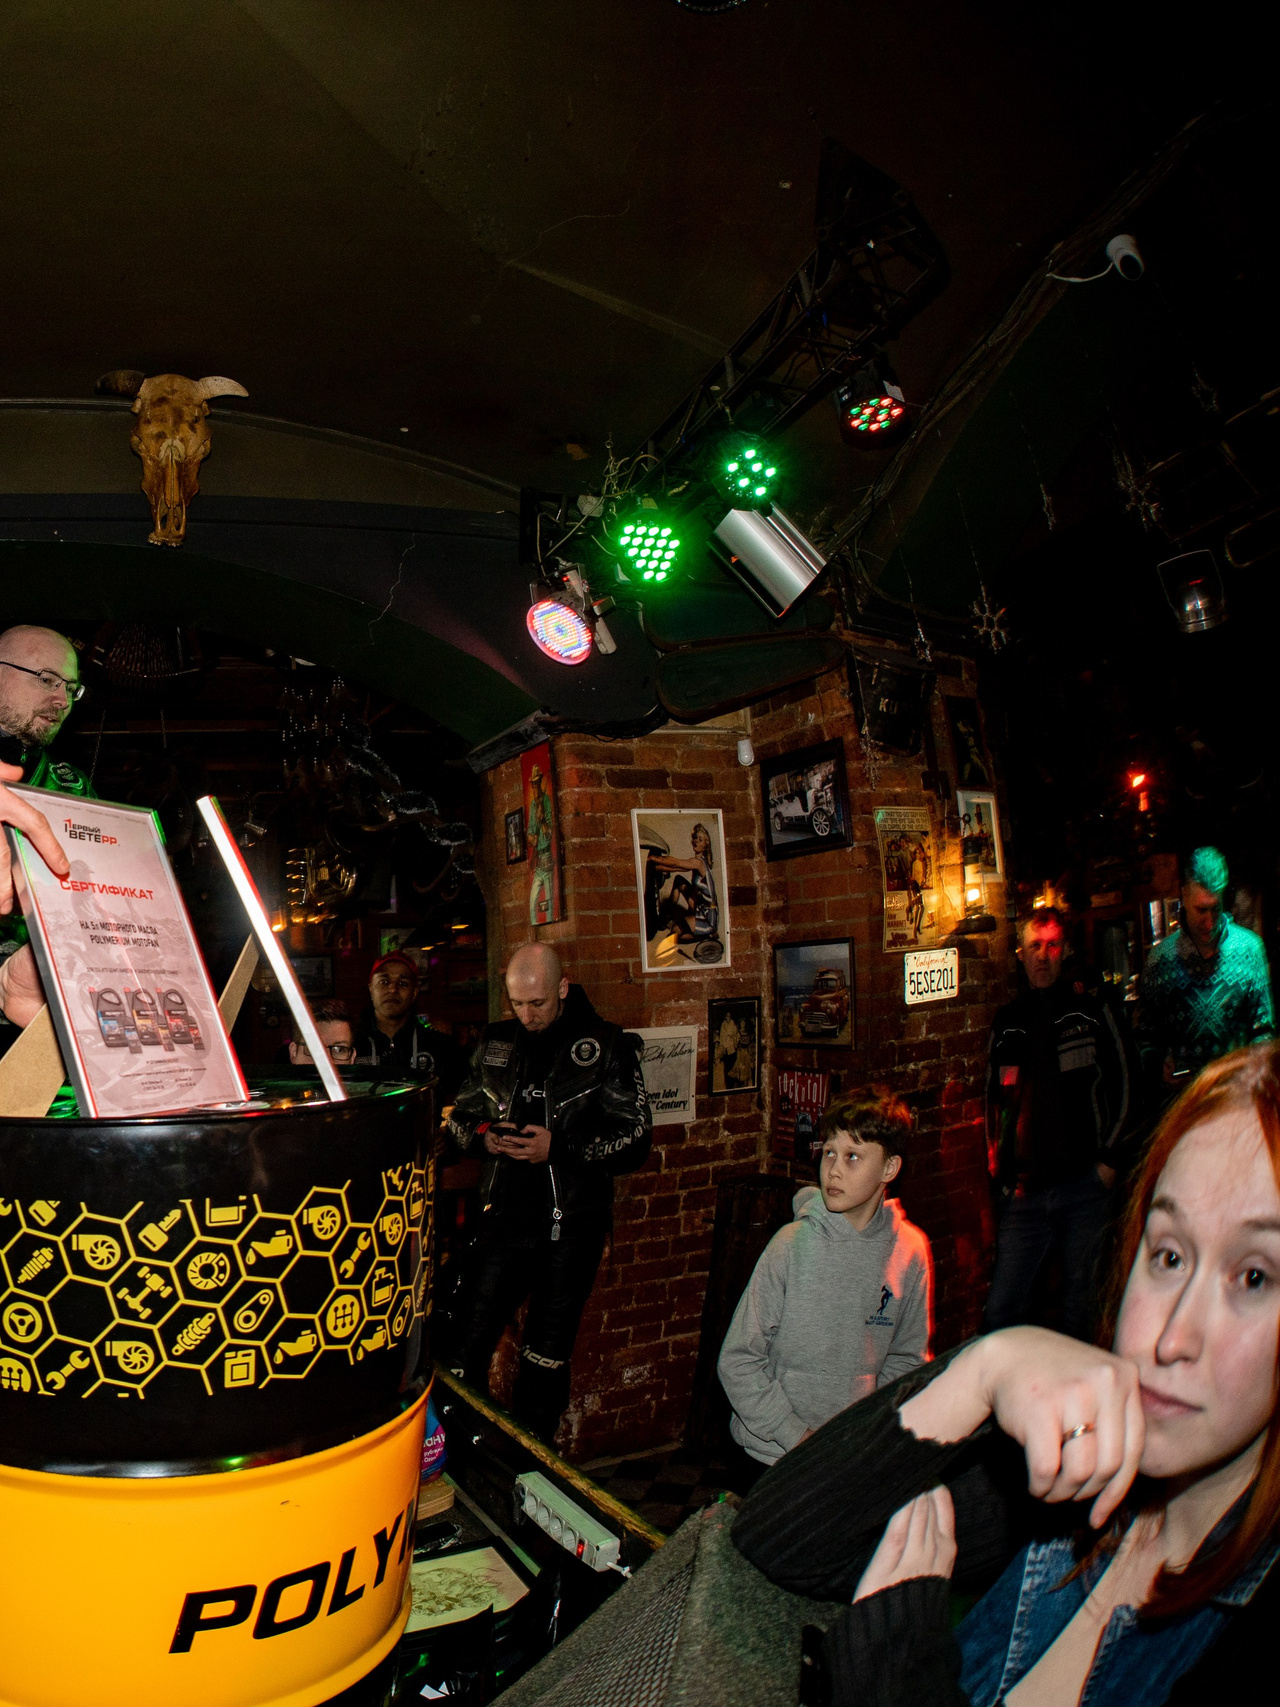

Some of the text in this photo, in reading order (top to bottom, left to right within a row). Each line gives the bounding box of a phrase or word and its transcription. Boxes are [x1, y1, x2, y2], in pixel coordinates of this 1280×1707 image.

[60, 879, 153, 900] СЕРТИФИКАТ
[79, 920, 90, 930] НА
[100, 922, 137, 933] МОТОРНОГО
[138, 925, 158, 936] МАСЛА
[131, 938, 159, 948] MOTOFAN
[916, 955, 948, 969] California
[909, 966, 955, 996] 5ESE201
[662, 1088, 678, 1099] Idol
[655, 1100, 688, 1110] Century
[604, 1133, 632, 1156] ICON
